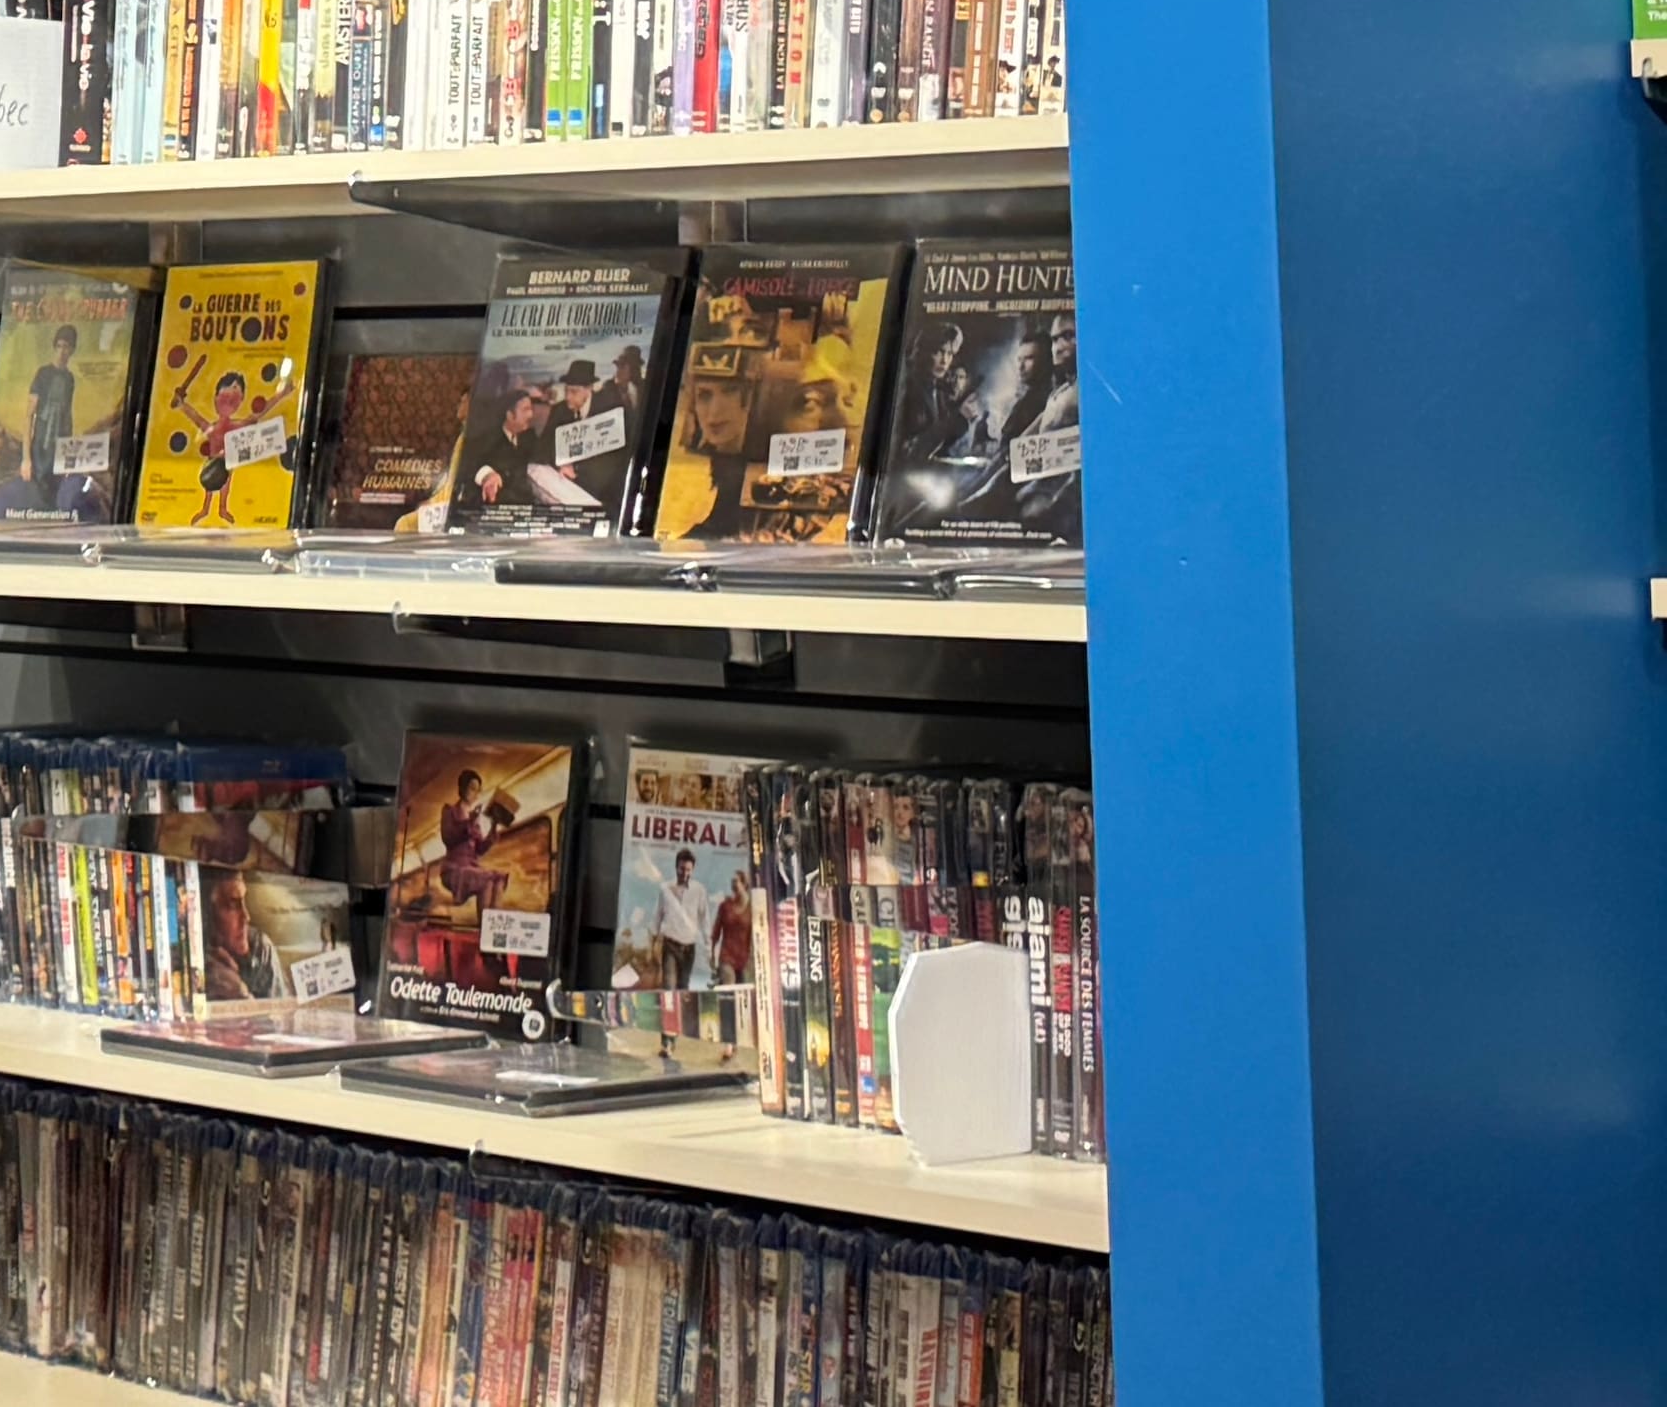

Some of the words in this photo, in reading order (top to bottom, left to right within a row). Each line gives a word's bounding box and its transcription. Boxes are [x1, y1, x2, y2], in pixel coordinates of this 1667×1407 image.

[318, 8, 333, 29] les
[318, 33, 333, 70] dans
[550, 15, 564, 82] FRISSON
[571, 16, 586, 81] FRISSON
[776, 35, 787, 73] LIGNE
[921, 15, 936, 69] RANGE
[448, 71, 460, 106] TOUT
[469, 72, 482, 107] TOUT
[351, 83, 362, 135] GRANDE
[529, 269, 591, 285] BERNARD
[594, 267, 631, 282] BLIER
[924, 265, 990, 294] MIND
[206, 292, 260, 315] GUERRE
[264, 298, 282, 313] DES
[501, 304, 517, 328] LE
[520, 303, 544, 327] CRI
[189, 313, 291, 343] BOUTONS
[363, 474, 432, 490] HUMAINES
[375, 457, 443, 475] COMÉDIES
[27, 508, 70, 521] Generation
[631, 813, 732, 849] LIBERAL
[1080, 895, 1091, 914] LA
[1028, 895, 1051, 1007] ajami
[1080, 916, 1092, 976] SOURCE
[390, 976, 441, 1003] Odette
[445, 981, 533, 1014] Toulemonde
[1081, 978, 1093, 1010] DES
[1080, 1011, 1094, 1073] FEMMES
